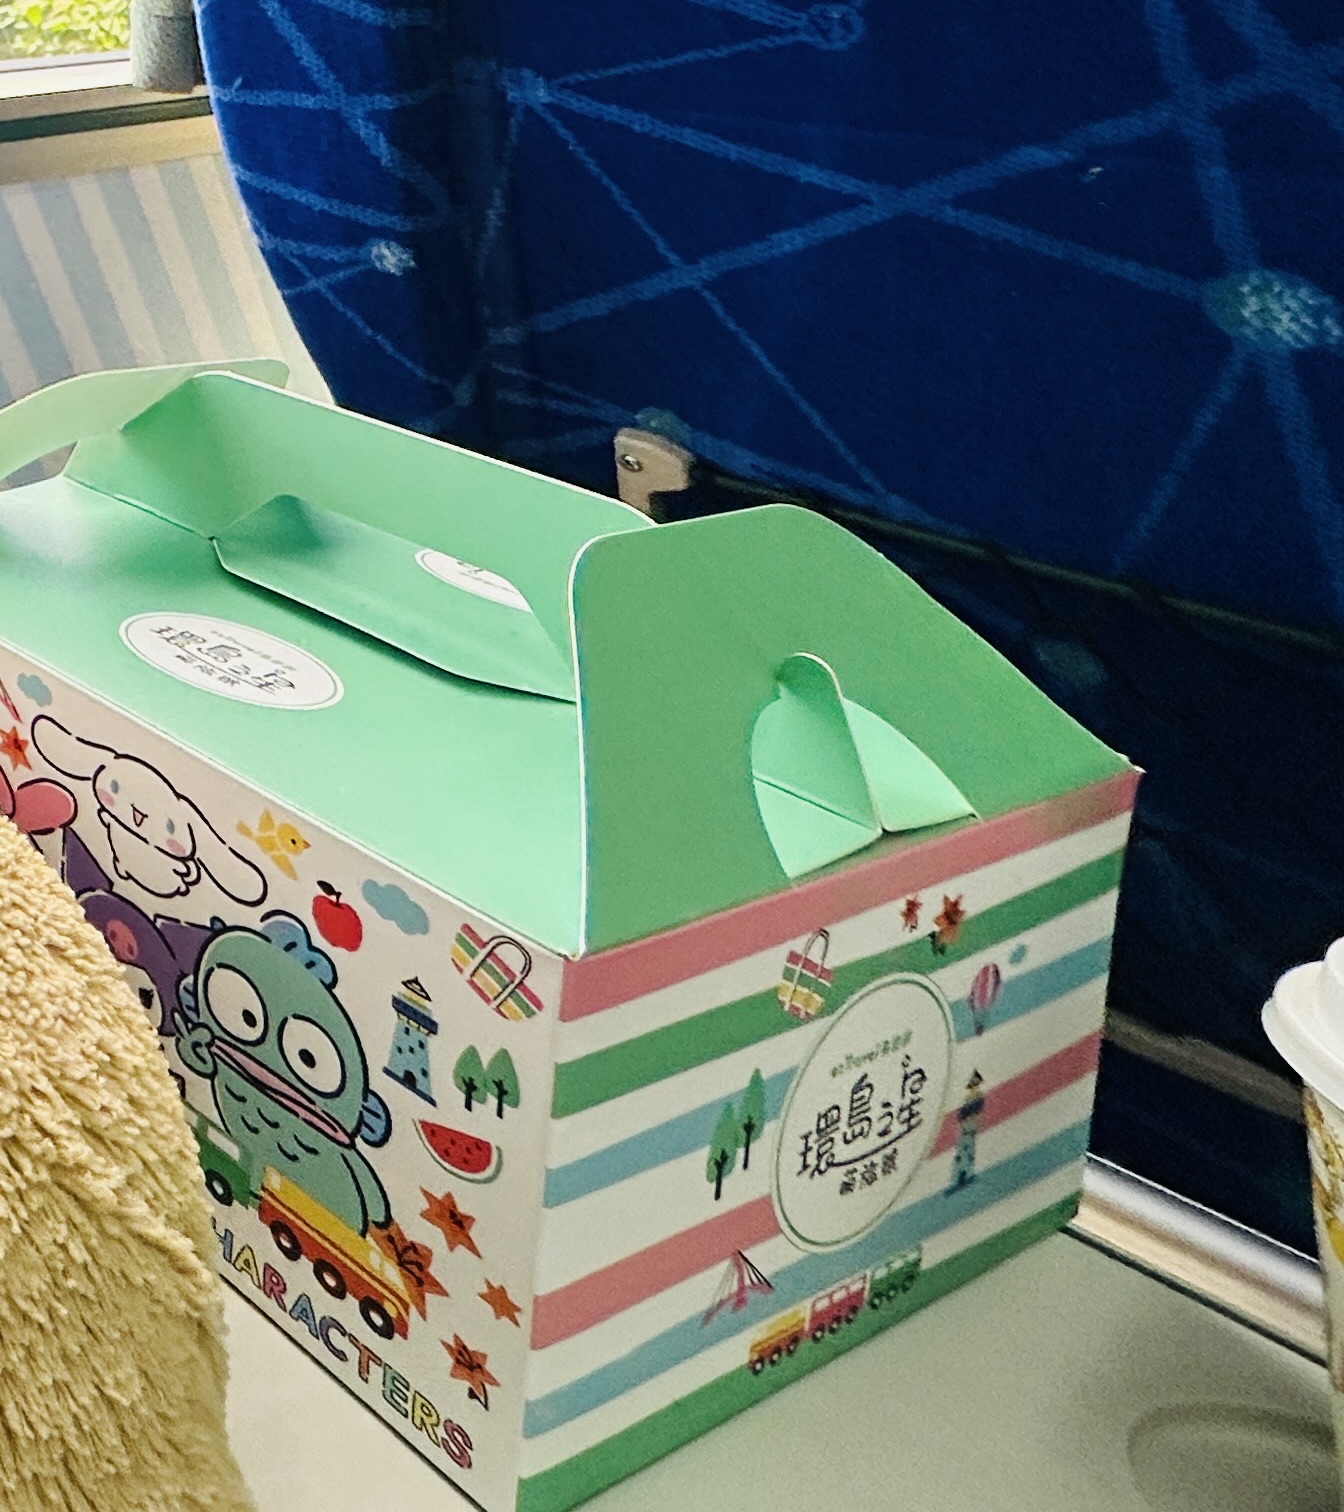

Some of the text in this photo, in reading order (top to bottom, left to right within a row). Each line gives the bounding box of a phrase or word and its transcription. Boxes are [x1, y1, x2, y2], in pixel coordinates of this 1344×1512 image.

[797, 1054, 928, 1180] 環島之星
[210, 1215, 474, 1470] HARACTERS
